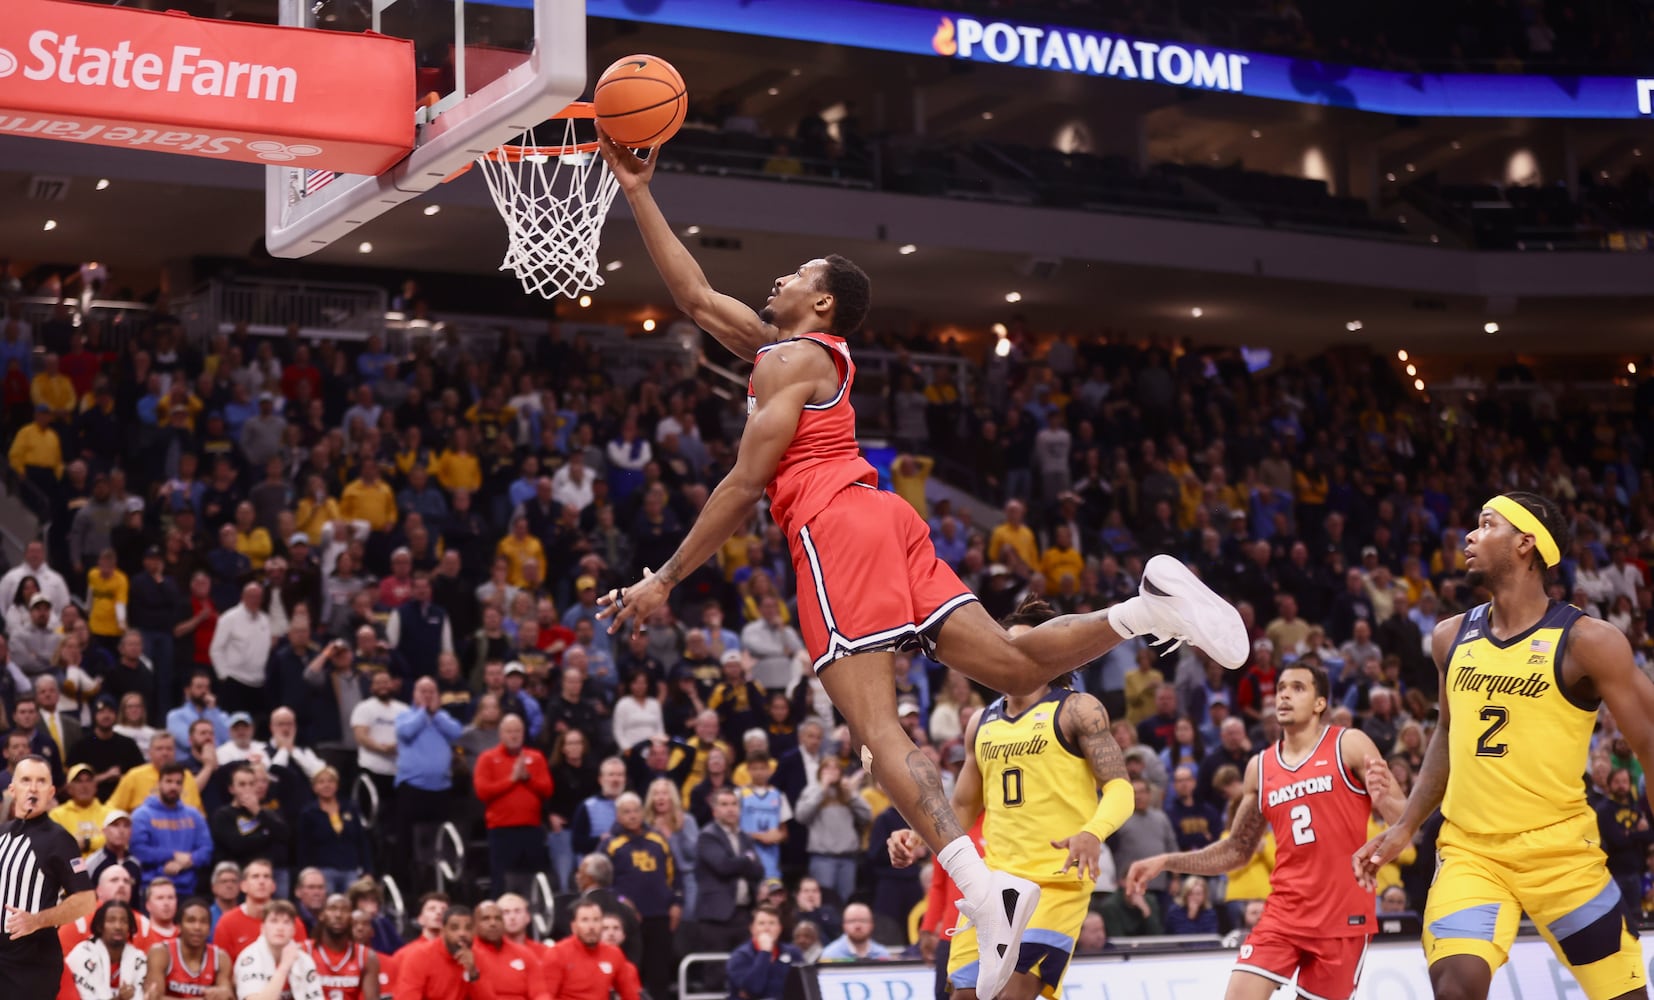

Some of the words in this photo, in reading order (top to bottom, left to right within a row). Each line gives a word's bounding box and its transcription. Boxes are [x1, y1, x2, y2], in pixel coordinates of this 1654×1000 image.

[957, 18, 1245, 91] POTAWATOMI
[1453, 666, 1551, 700] Marquette
[981, 734, 1049, 765] Marquette
[1475, 705, 1510, 758] 2
[1001, 766, 1025, 809] 0
[1268, 774, 1334, 808] DAYTON
[1289, 803, 1317, 846] 2
